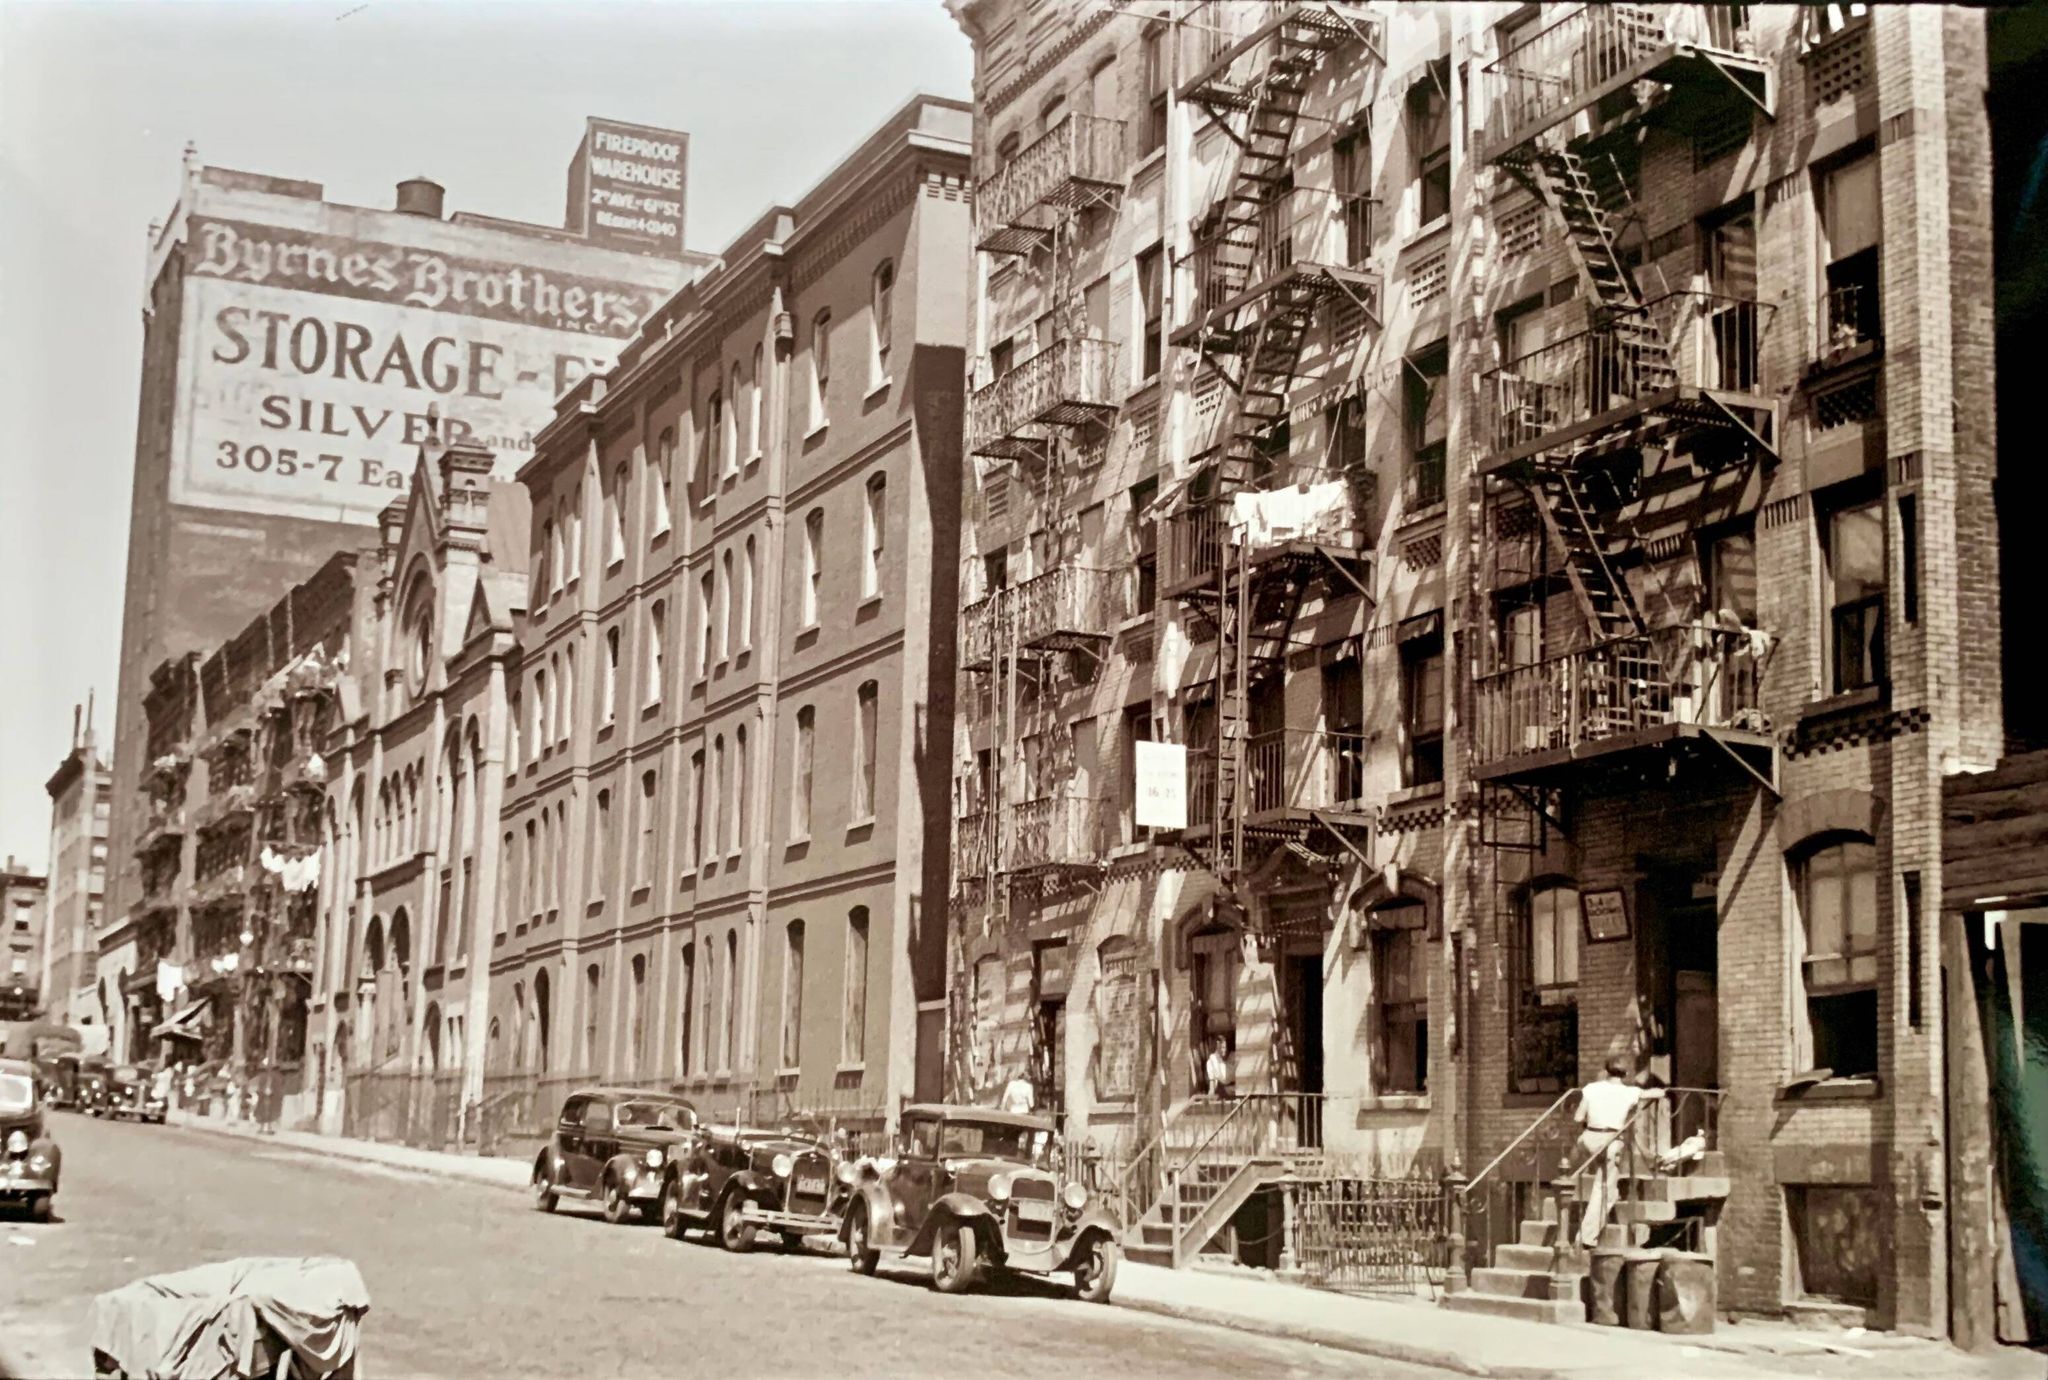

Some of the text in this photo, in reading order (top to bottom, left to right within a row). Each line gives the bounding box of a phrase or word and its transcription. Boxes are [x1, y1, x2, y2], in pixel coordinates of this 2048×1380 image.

[595, 131, 681, 163] FIREPROOF
[591, 155, 682, 190] WAREHOUSE
[194, 222, 638, 329] Byrnes Brothers
[213, 306, 503, 401] STORAGE
[486, 431, 532, 452] and
[217, 440, 343, 482] 305-7
